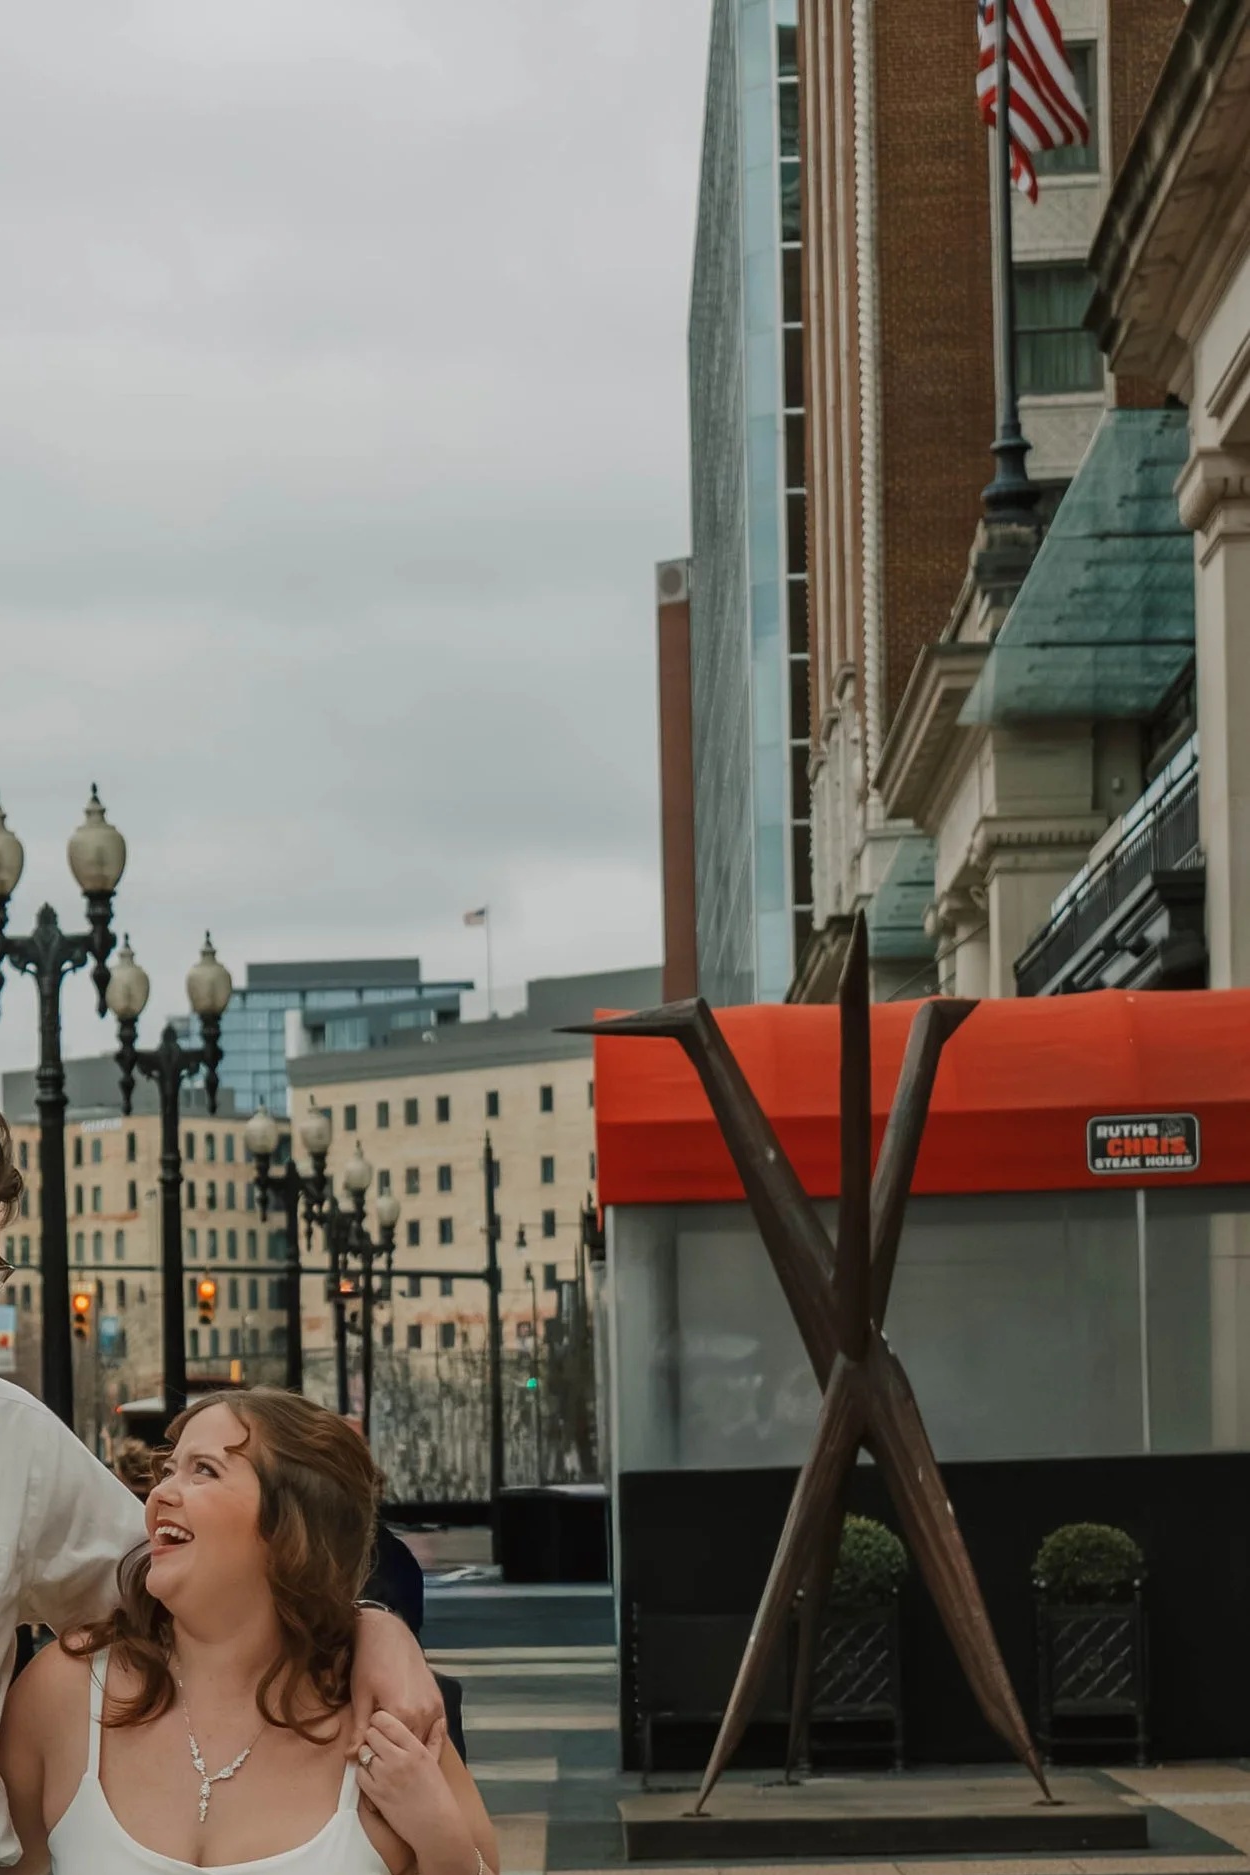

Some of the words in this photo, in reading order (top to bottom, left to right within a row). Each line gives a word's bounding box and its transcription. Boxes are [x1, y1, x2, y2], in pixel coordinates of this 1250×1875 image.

[1096, 1123, 1158, 1138] RUTH'S
[1107, 1136, 1186, 1157] CHRIS
[1095, 1157, 1140, 1169] STEAK
[1146, 1155, 1193, 1167] HOUSE
